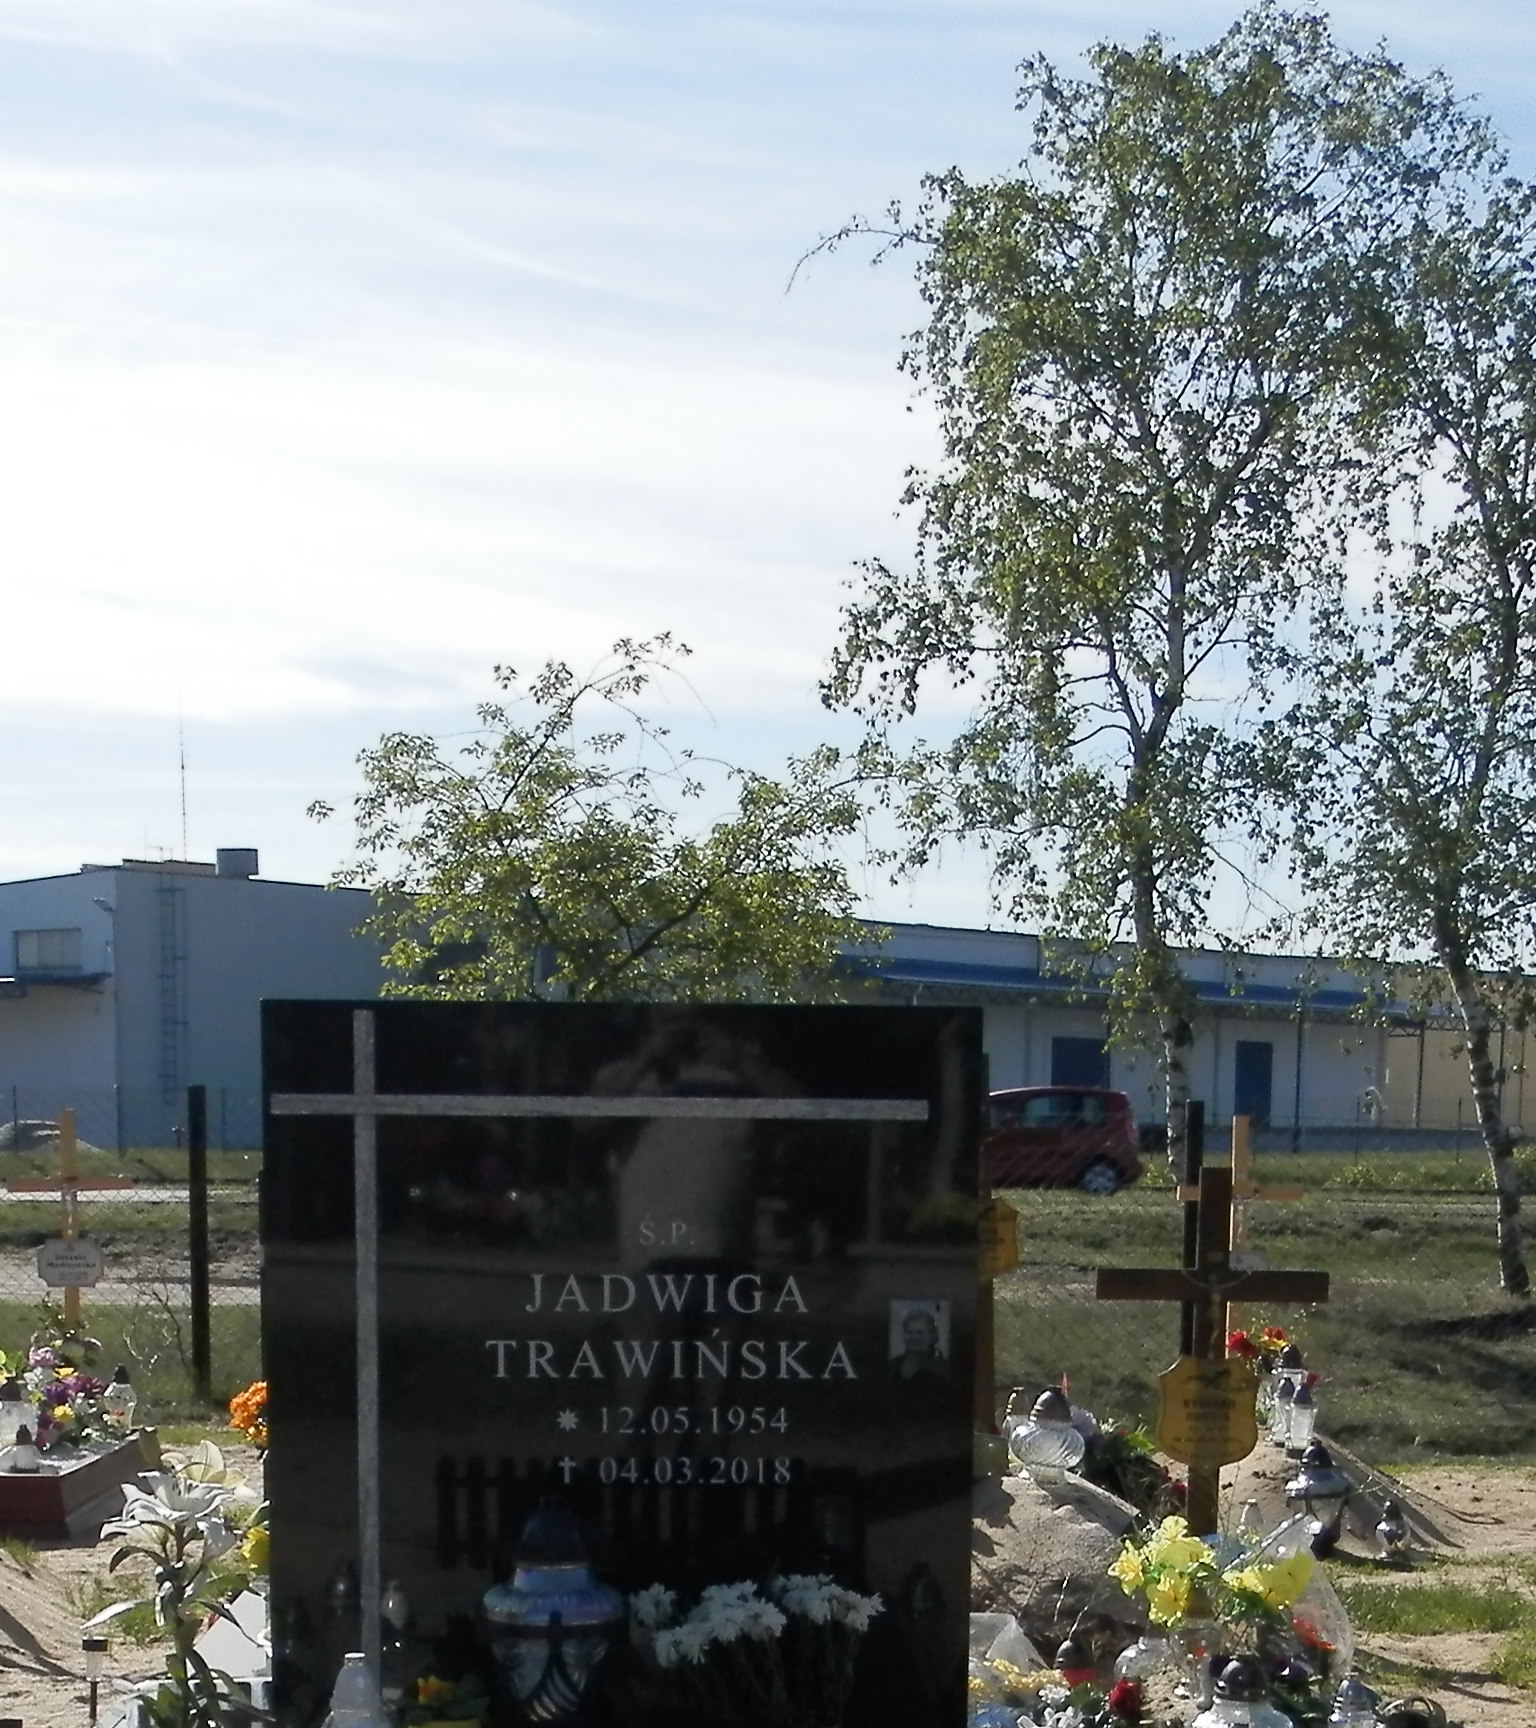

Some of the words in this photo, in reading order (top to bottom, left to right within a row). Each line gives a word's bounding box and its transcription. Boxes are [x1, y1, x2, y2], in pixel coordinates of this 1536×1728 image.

[638, 1212, 696, 1247] Ś.P.
[524, 1272, 810, 1315] JADWIGA
[485, 1327, 860, 1381] TRAWIŃSKA
[599, 1406, 789, 1435] 12.05.1954
[598, 1456, 793, 1486] 04.03.2018
